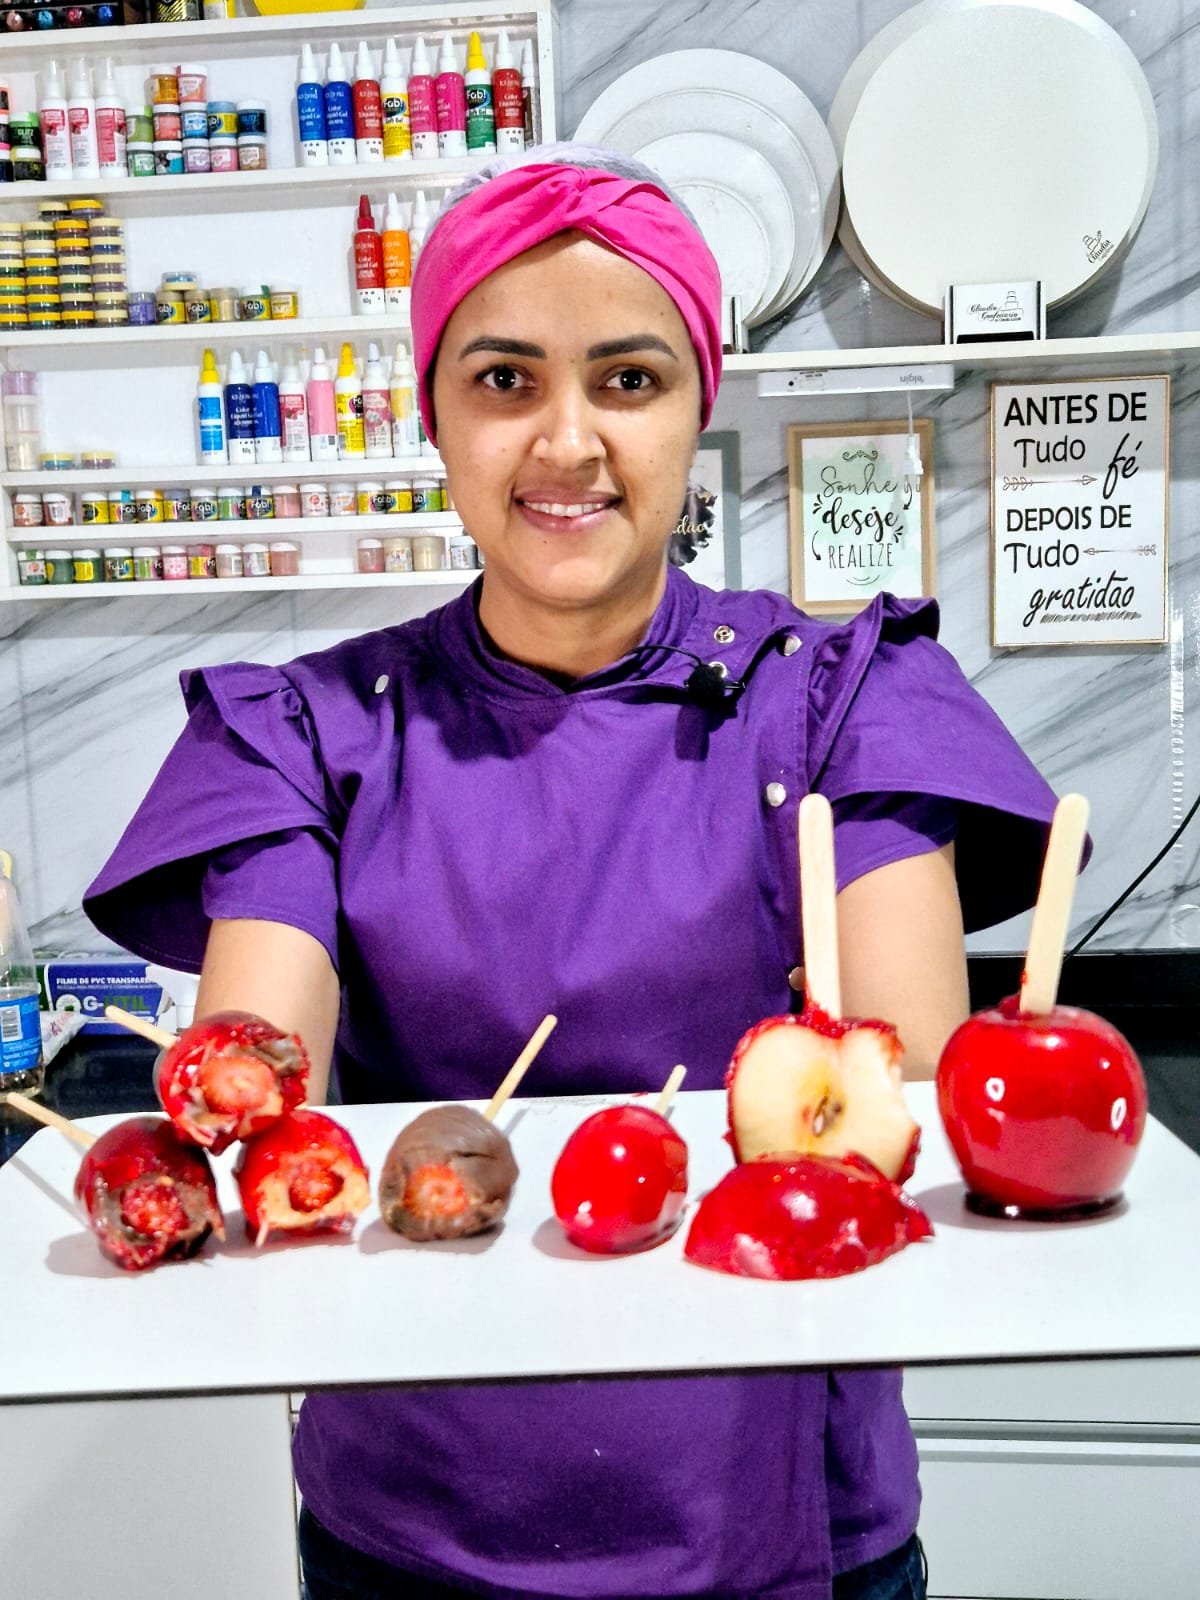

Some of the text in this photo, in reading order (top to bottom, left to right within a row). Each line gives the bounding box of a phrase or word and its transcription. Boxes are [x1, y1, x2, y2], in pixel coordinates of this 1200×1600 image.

[1003, 392, 1147, 427] ANTES DE
[820, 463, 899, 498] Sonhe
[1013, 433, 1143, 500] Tudo fé
[821, 496, 900, 543] deseje
[1007, 504, 1132, 532] DEPOIS DE
[828, 543, 894, 569] REALIZE
[1003, 539, 1080, 574] Tudo
[1022, 570, 1135, 627] gratidão
[56, 977, 78, 985] FILME
